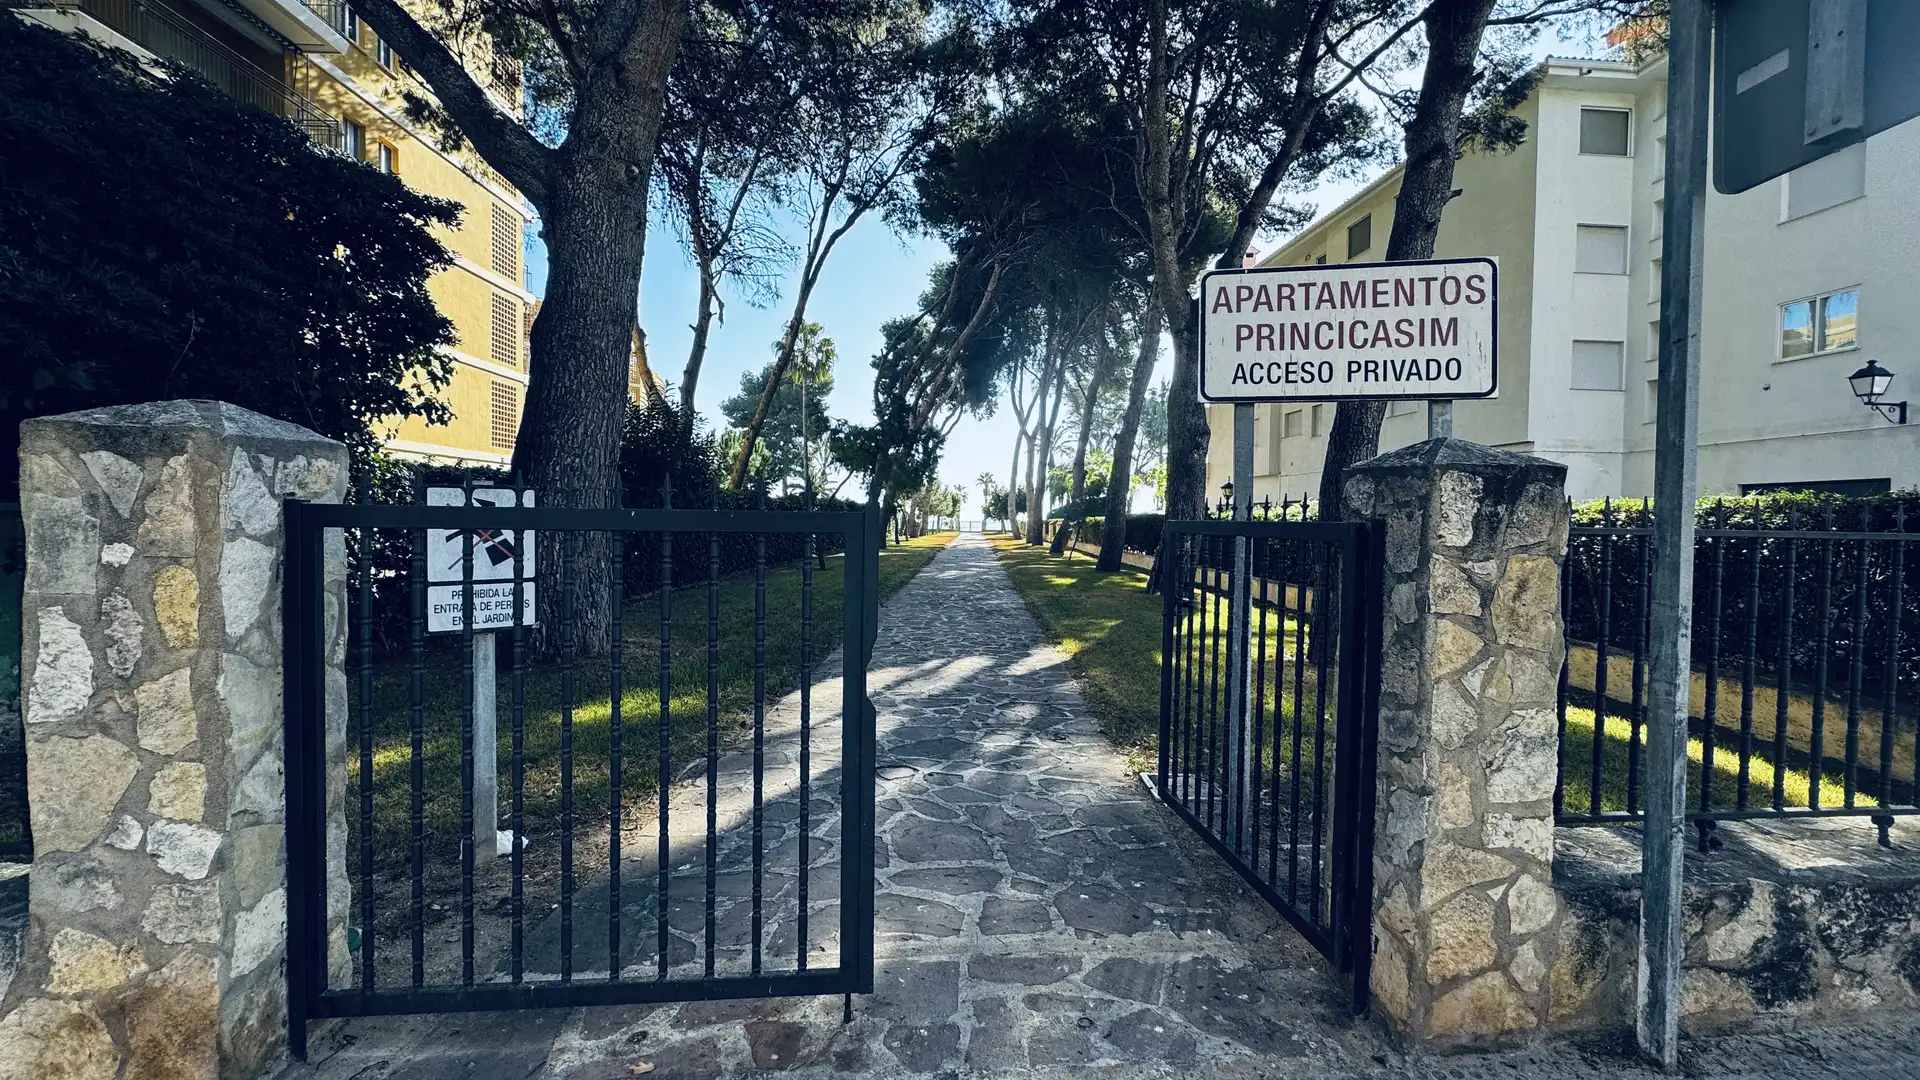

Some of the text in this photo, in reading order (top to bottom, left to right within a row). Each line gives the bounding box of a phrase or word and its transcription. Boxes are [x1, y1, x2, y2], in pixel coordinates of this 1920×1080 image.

[1211, 274, 1486, 314] APARTAMENTOS
[1236, 317, 1459, 351] PRINCICASIM
[1231, 357, 1462, 385] ACCESO PRIVADO
[434, 599, 530, 614] ENTRAA DE PERS
[452, 588, 500, 600] PRHIBIDA
